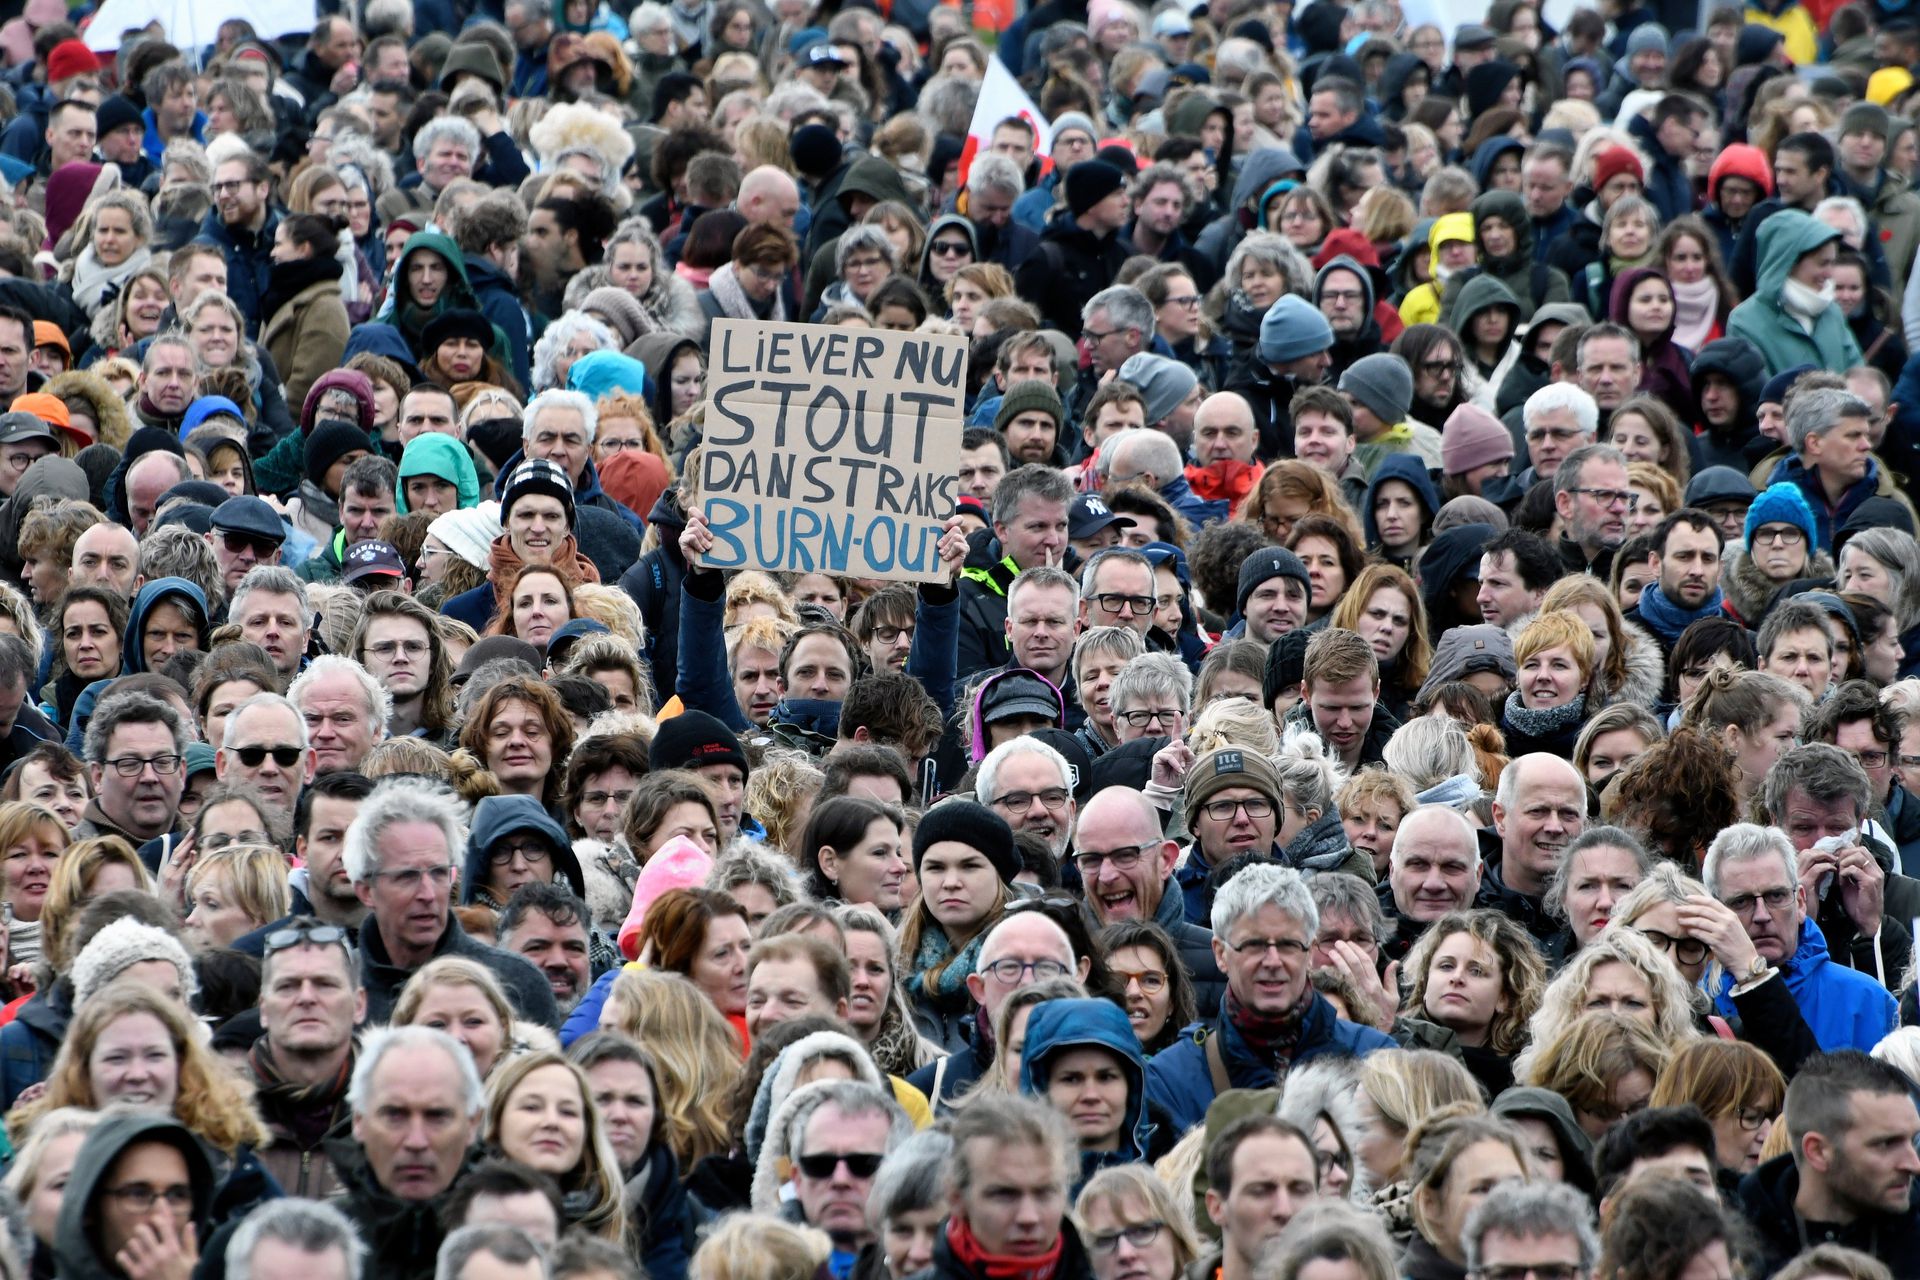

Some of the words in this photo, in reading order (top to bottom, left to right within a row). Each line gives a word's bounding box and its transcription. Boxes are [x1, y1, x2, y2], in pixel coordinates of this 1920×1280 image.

[894, 341, 965, 388] NU
[708, 380, 955, 464] STOUT
[704, 449, 797, 499] DAN
[802, 456, 959, 521] STRAKS
[349, 543, 388, 559] CANADA
